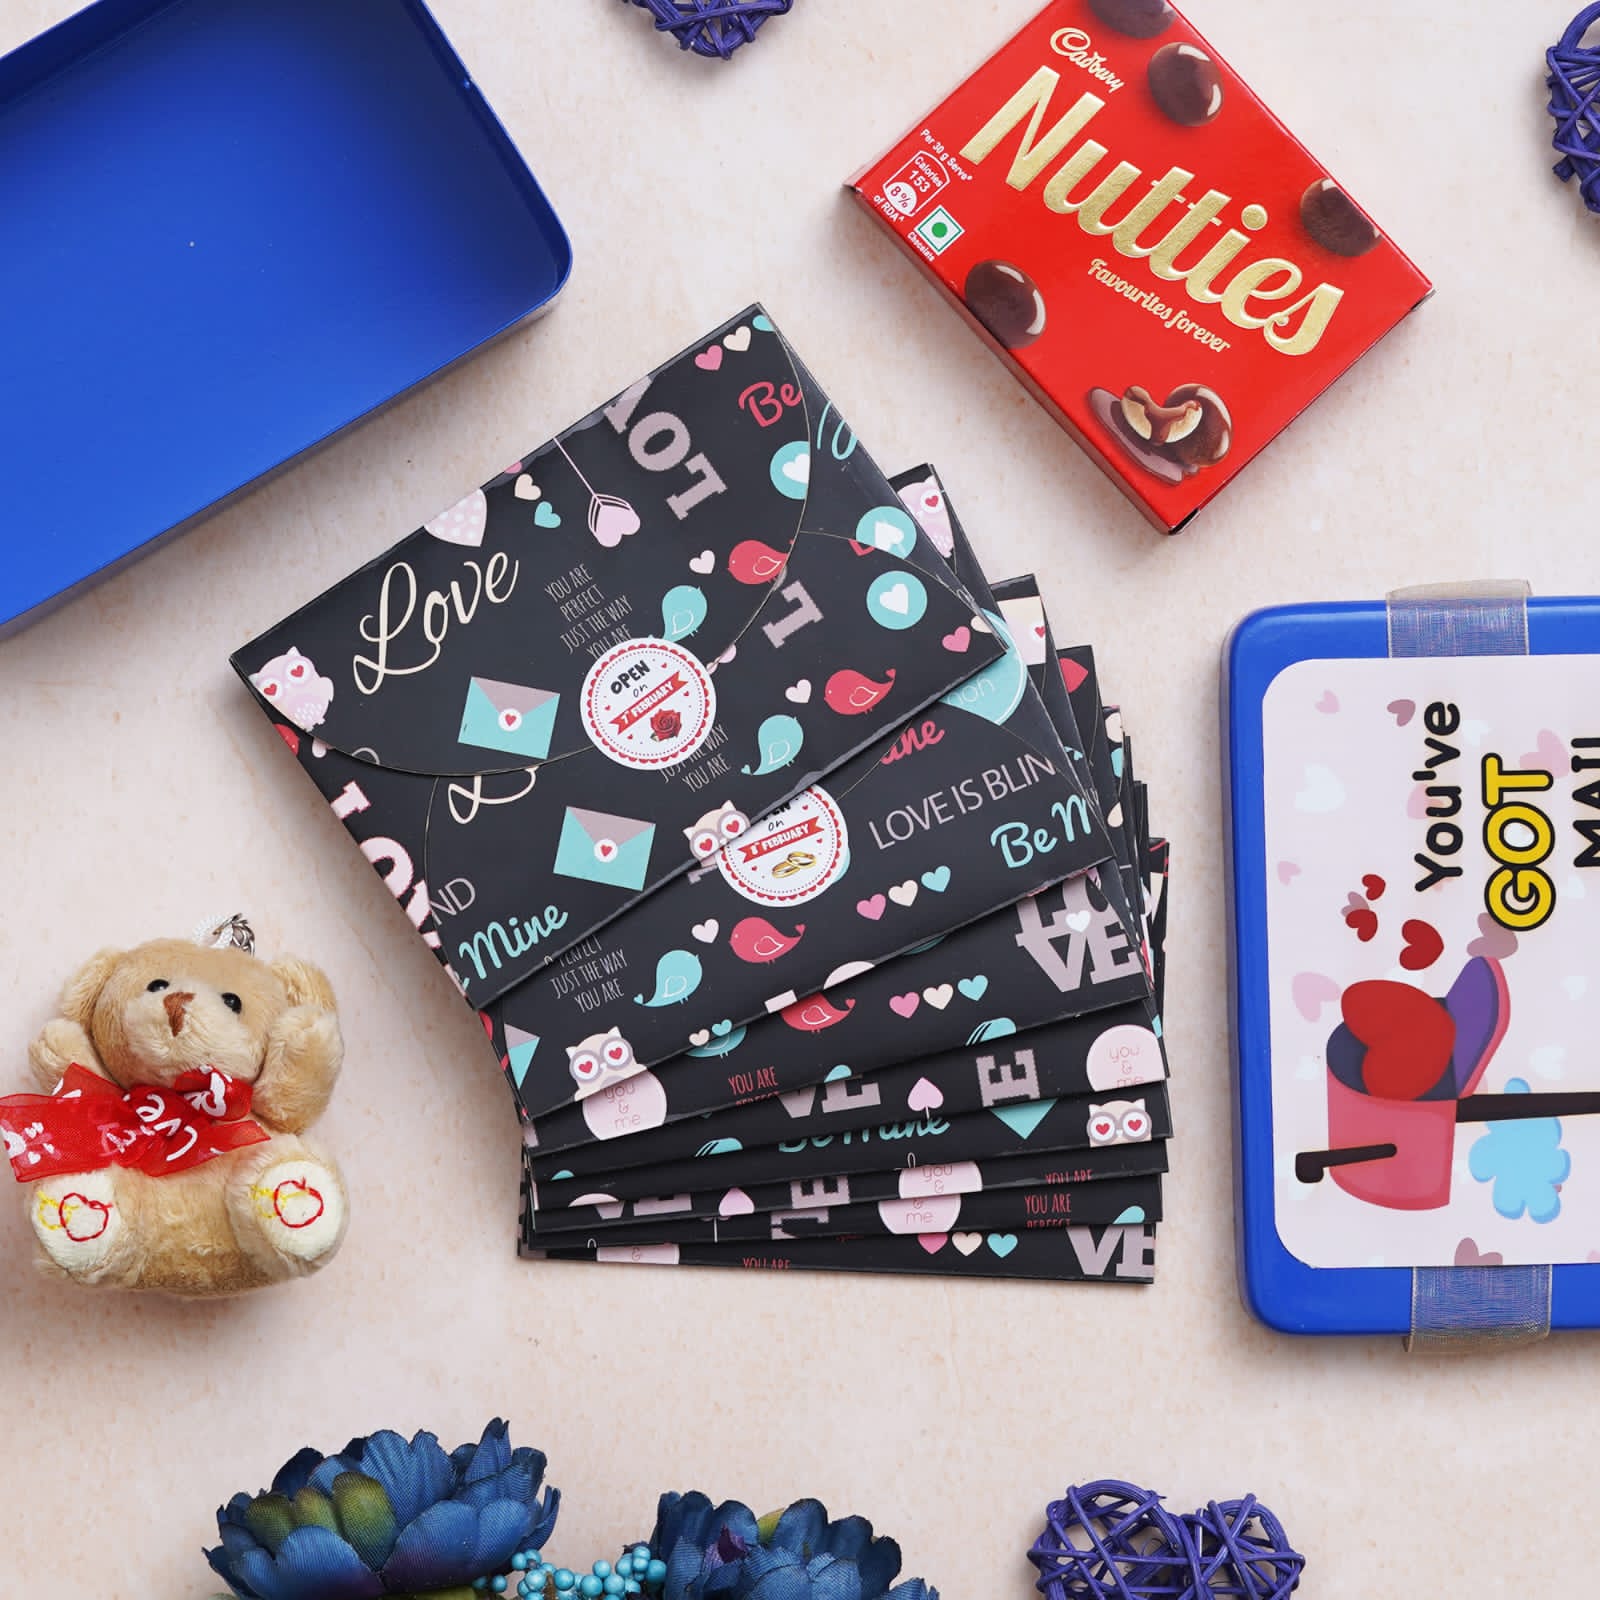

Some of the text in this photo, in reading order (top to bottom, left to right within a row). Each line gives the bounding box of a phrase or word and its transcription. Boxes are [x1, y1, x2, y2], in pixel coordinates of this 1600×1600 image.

[1050, 27, 1124, 93] Cadbury
[920, 128, 935, 145] Per
[932, 142, 945, 154] 30
[939, 153, 949, 162] g
[908, 169, 931, 193] 153
[914, 156, 944, 188] Calories
[873, 194, 885, 206] of
[959, 65, 1345, 356] Nutties
[907, 231, 935, 262] Chocolate
[1087, 258, 1232, 353] Favourites forever
[738, 381, 803, 428] Be
[544, 563, 593, 603] YOU ARE
[559, 583, 605, 622] PERFECT
[353, 551, 519, 695] Love
[560, 595, 633, 655] JUST THE WAY
[610, 660, 650, 695] OPEN
[633, 684, 648, 698] on
[630, 681, 674, 717] FEBRUARY
[681, 766, 709, 793] YOU
[706, 753, 731, 779] ARE
[1412, 701, 1463, 891] You've
[768, 820, 784, 832] on
[868, 791, 954, 850] LOVE
[951, 779, 984, 815] IS
[761, 823, 809, 851] FEBRUARY
[990, 821, 1058, 869] Be
[1481, 752, 1556, 931] GOT
[458, 904, 569, 980] Mine
[550, 948, 628, 999] JUST THE WAY
[574, 978, 625, 1013] YOU ARE
[1109, 1046, 1140, 1063] you
[604, 1082, 635, 1104] you
[728, 1066, 779, 1095] YOU ARE
[614, 1113, 641, 1130] me
[906, 1211, 934, 1225] me
[1024, 1193, 1072, 1215] YOU ARE
